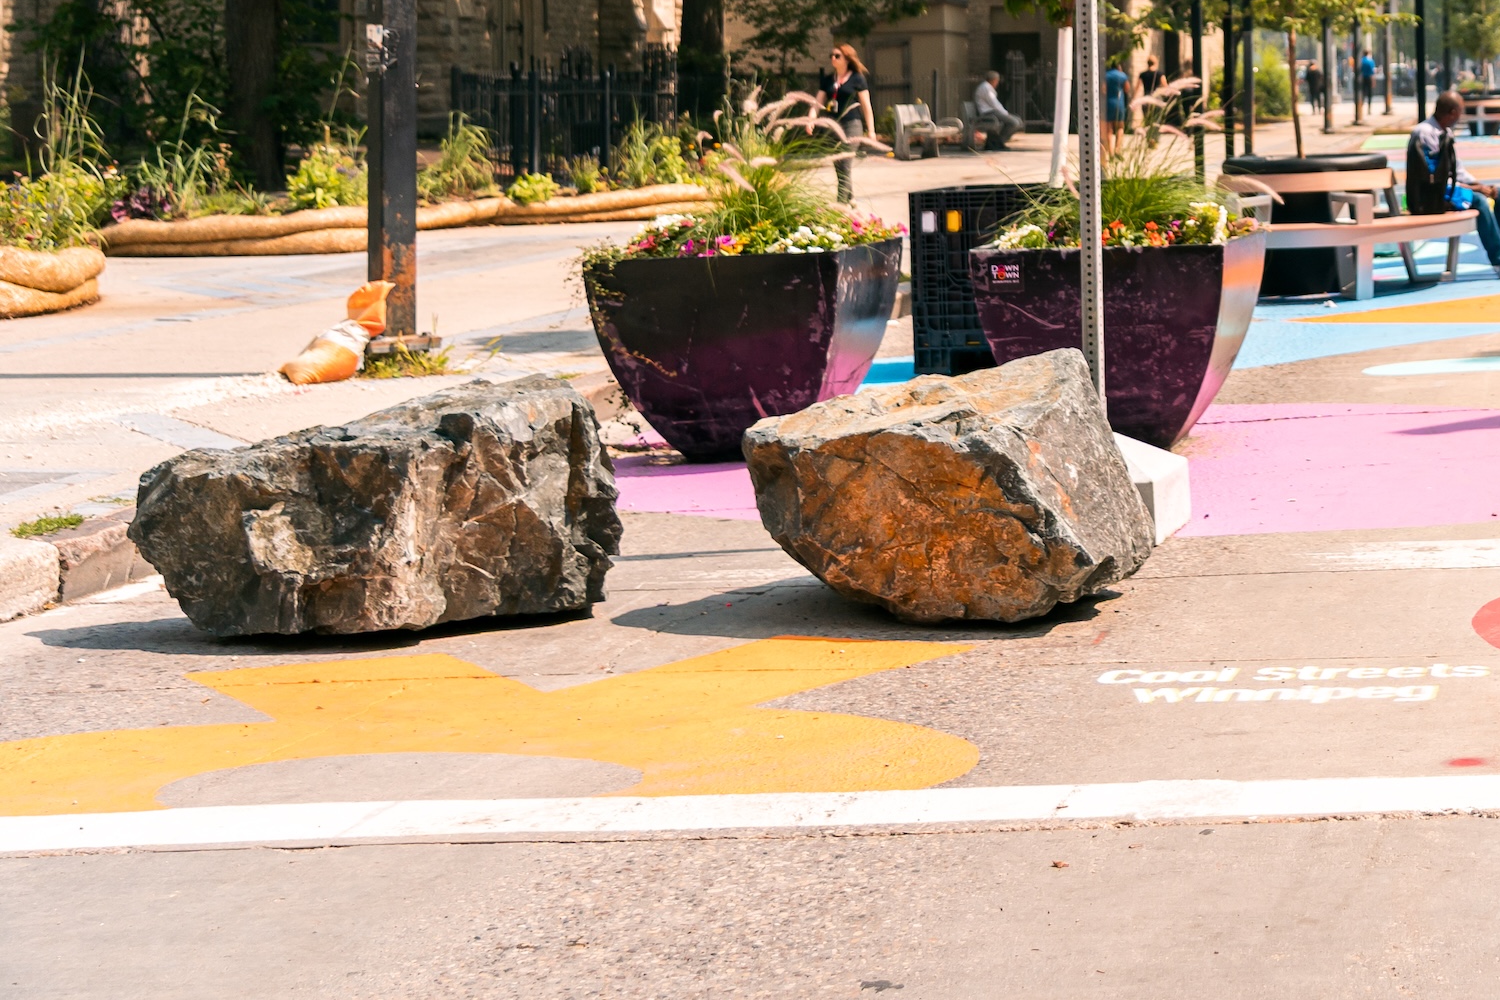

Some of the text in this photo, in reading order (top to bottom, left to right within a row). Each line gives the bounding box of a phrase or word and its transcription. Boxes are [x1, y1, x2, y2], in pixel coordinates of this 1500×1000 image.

[991, 264, 1020, 272] DOWN
[991, 271, 1020, 280] TOWN
[1097, 663, 1491, 684] Cool Streets
[1132, 684, 1440, 704] Winnipeg
